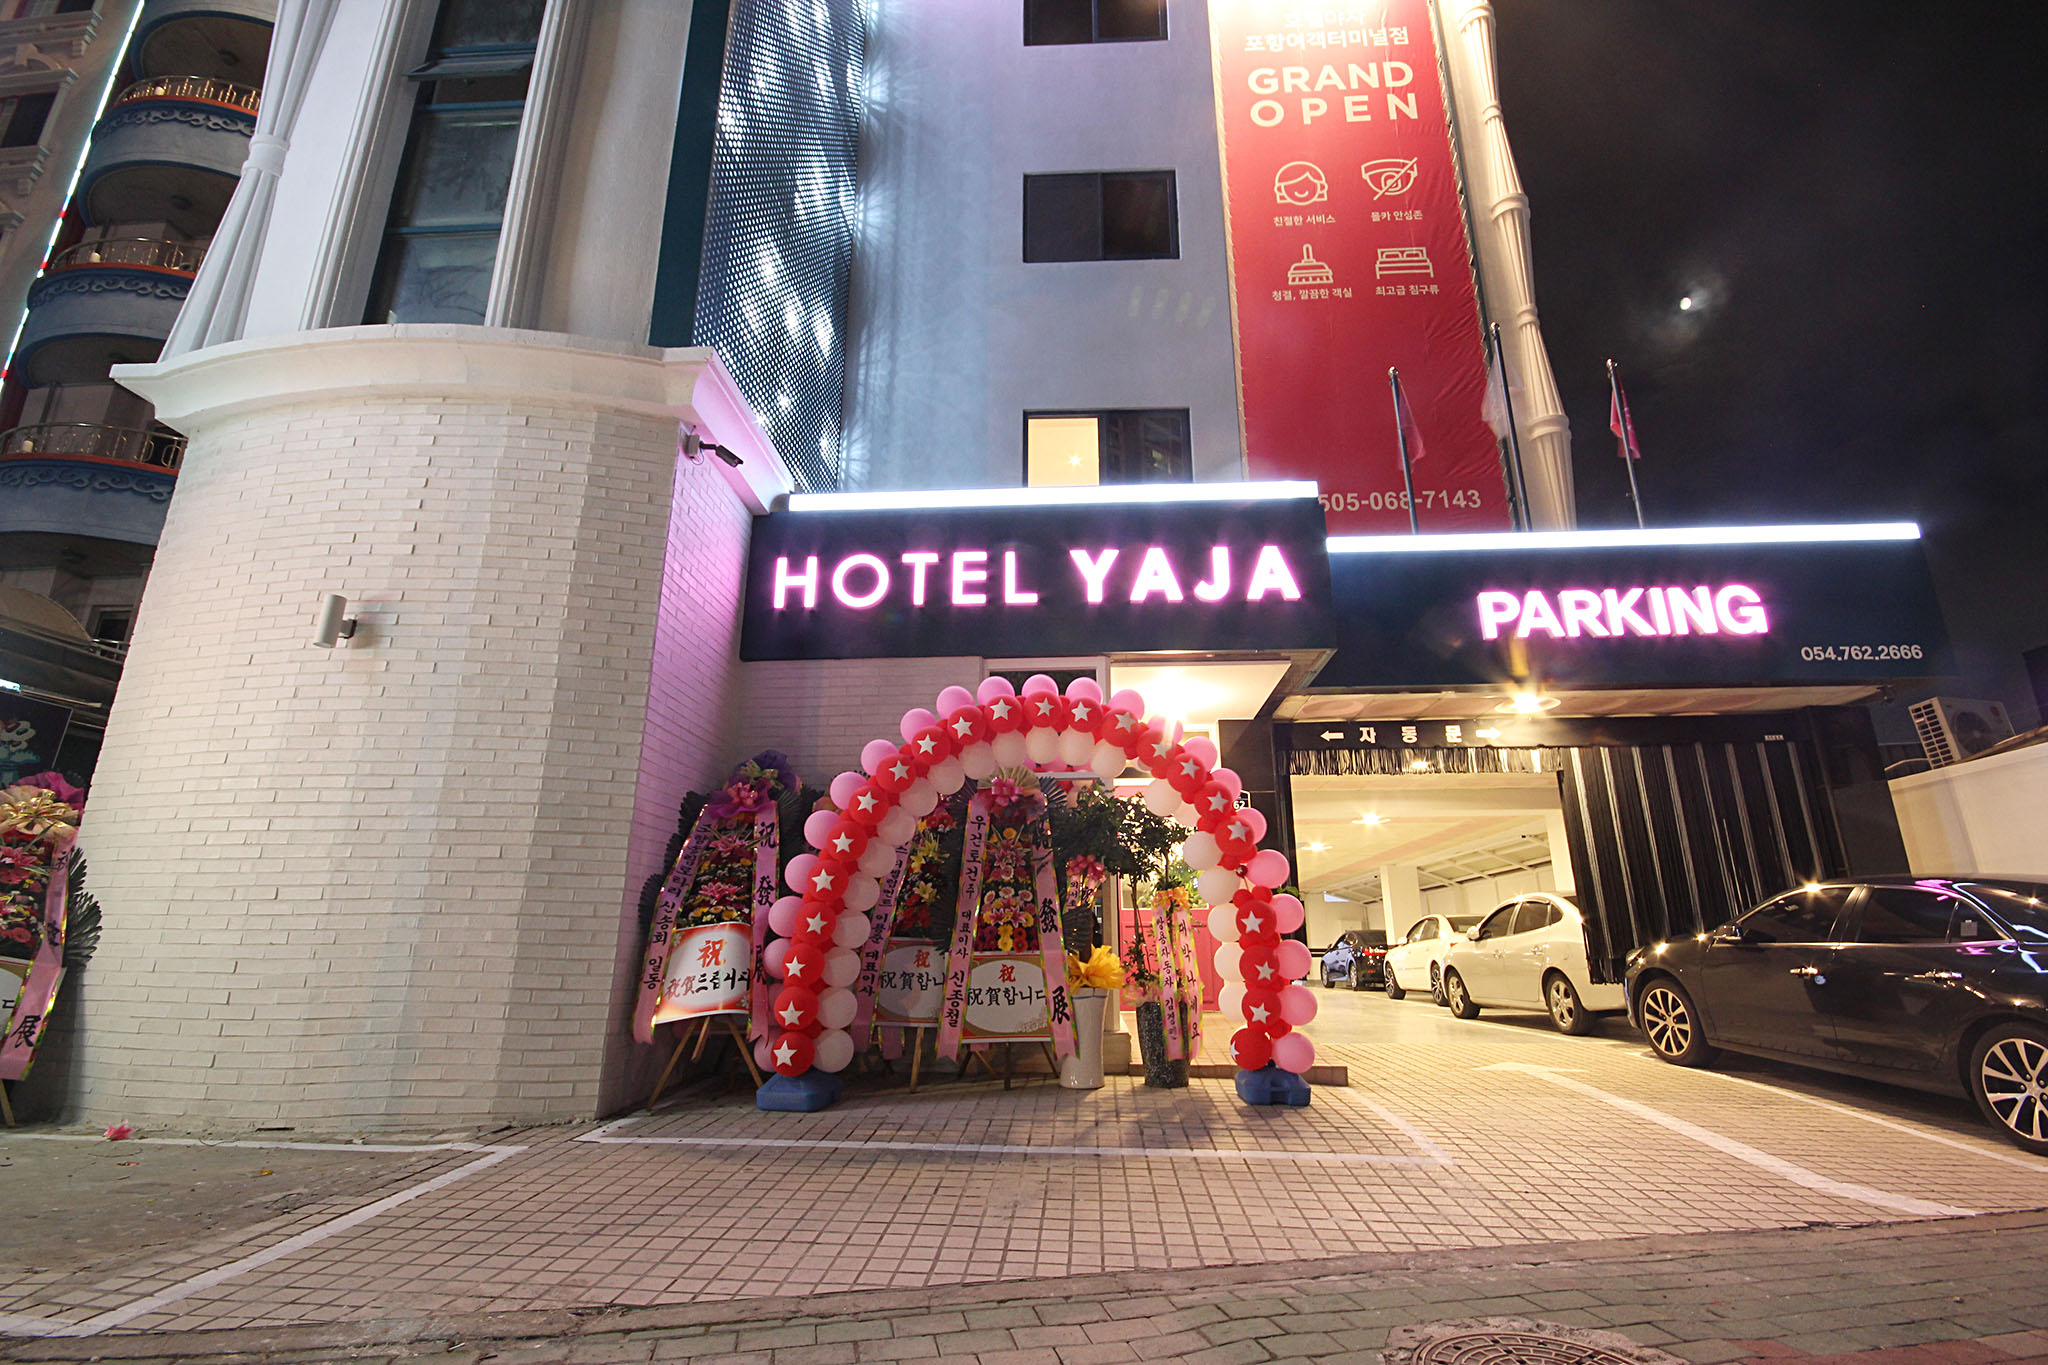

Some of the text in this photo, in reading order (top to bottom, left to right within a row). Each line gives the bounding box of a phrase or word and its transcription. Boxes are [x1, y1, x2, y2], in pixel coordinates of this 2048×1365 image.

[1244, 26, 1409, 52] 포항여객터미널점
[1247, 61, 1414, 94] GRAND
[1250, 93, 1418, 127] OPEN
[1273, 214, 1336, 227] 친절한 서비스
[1299, 288, 1330, 299] 깔끔한
[1331, 287, 1353, 298] 객실
[1375, 284, 1440, 296] 최고급 침구류
[772, 545, 1302, 609] HOTEL YAJA
[1477, 583, 1769, 641] PARKING
[1800, 644, 1924, 662] 054.762.2666
[955, 910, 972, 959] 대표이사
[697, 939, 727, 968] 祝
[913, 949, 931, 968] 祝
[643, 956, 663, 990] 일동
[858, 950, 879, 997] 대표이사
[879, 971, 946, 991] 祝賀합니
[998, 963, 1017, 983] 祝
